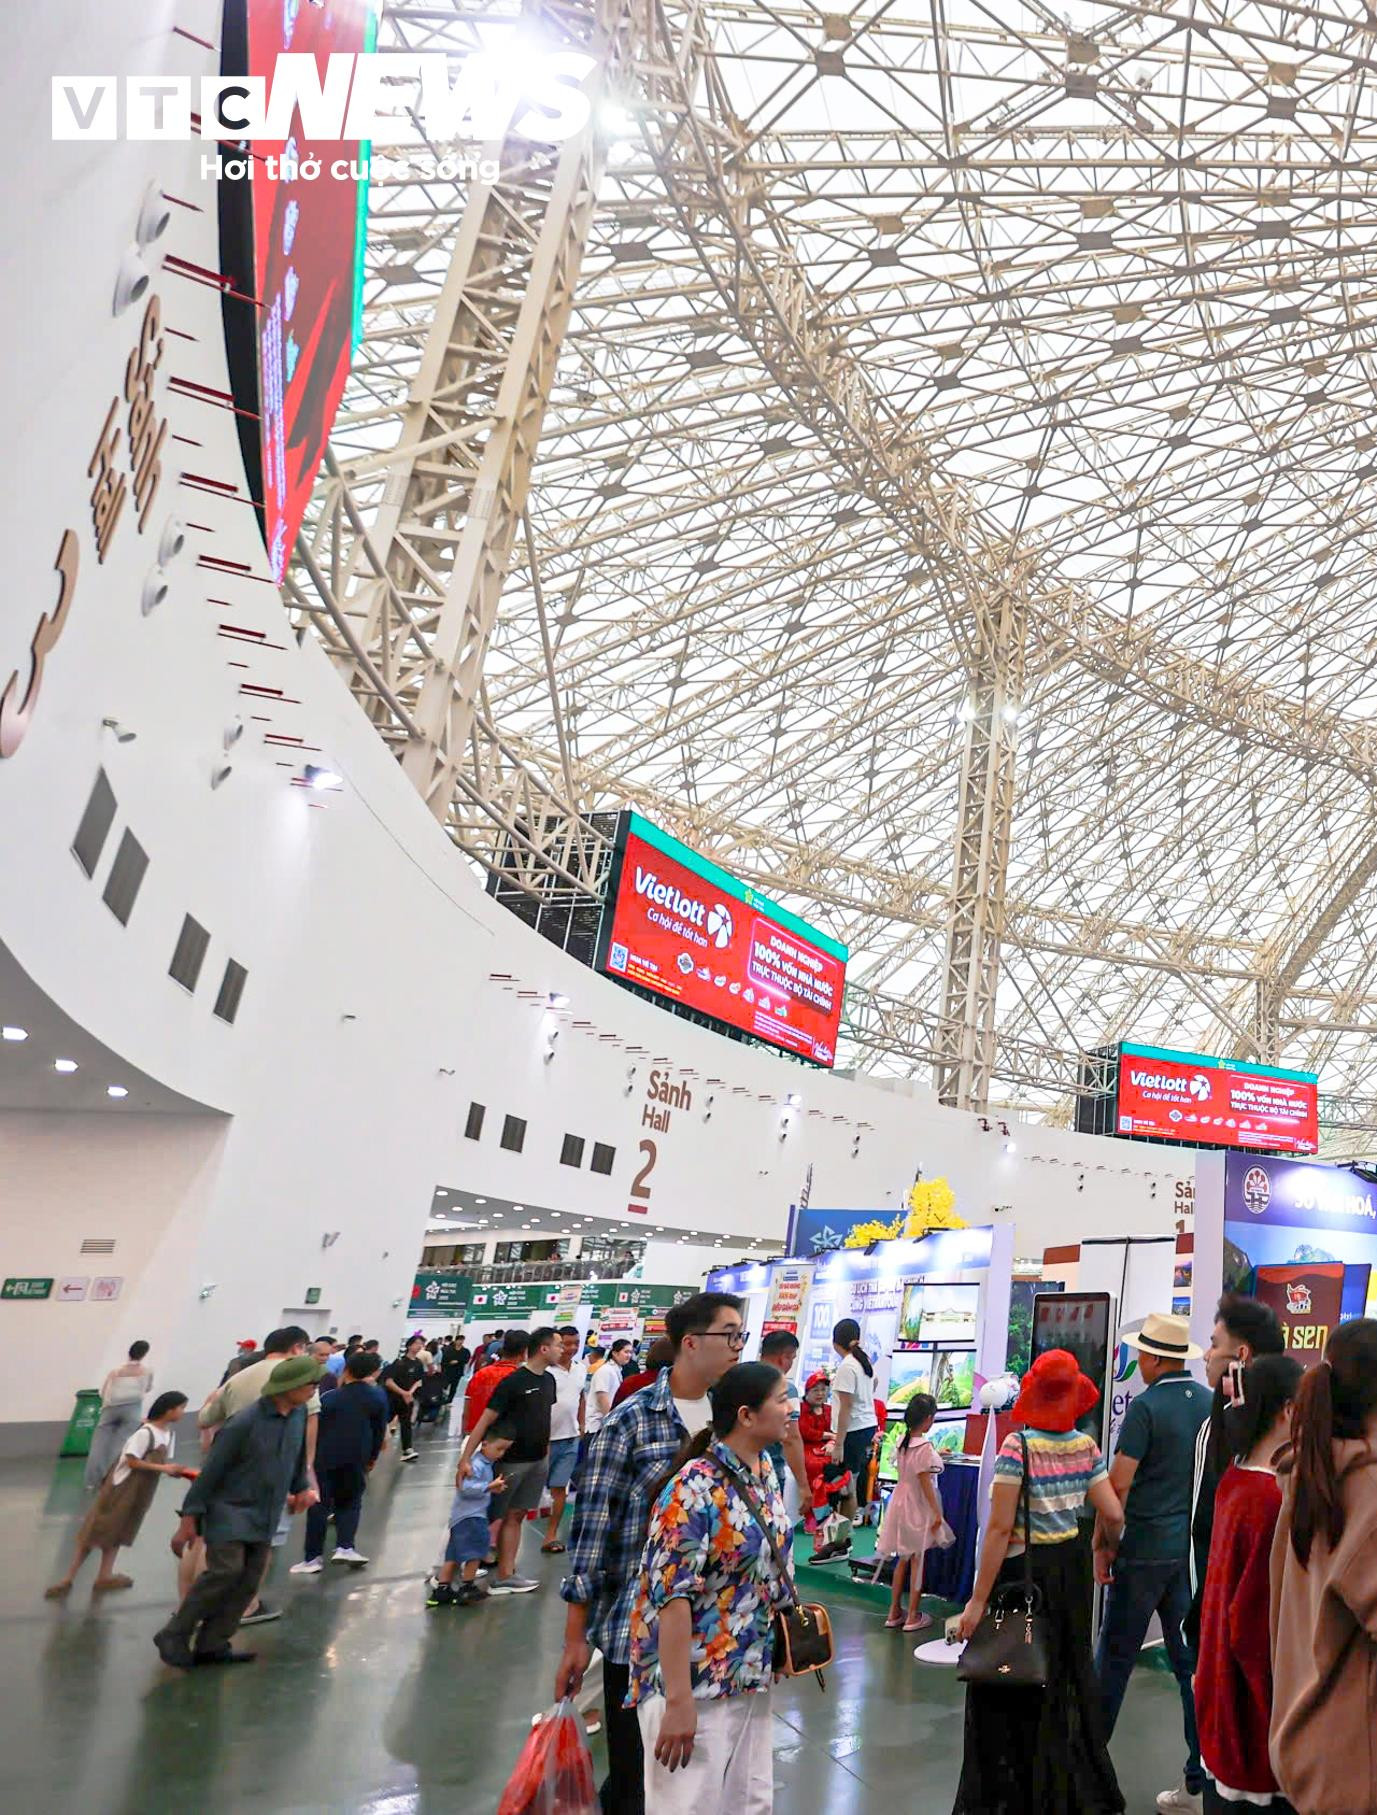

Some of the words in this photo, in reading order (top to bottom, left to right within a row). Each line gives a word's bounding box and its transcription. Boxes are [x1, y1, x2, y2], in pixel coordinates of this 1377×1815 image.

[635, 866, 706, 926] Vietlott
[754, 941, 781, 970] 100%
[647, 1069, 692, 1111] Sảnh
[1130, 1070, 1187, 1092] Vietlott
[1230, 1089, 1256, 1102] 100%
[642, 1103, 672, 1133] Hall
[630, 1139, 657, 1199] 2
